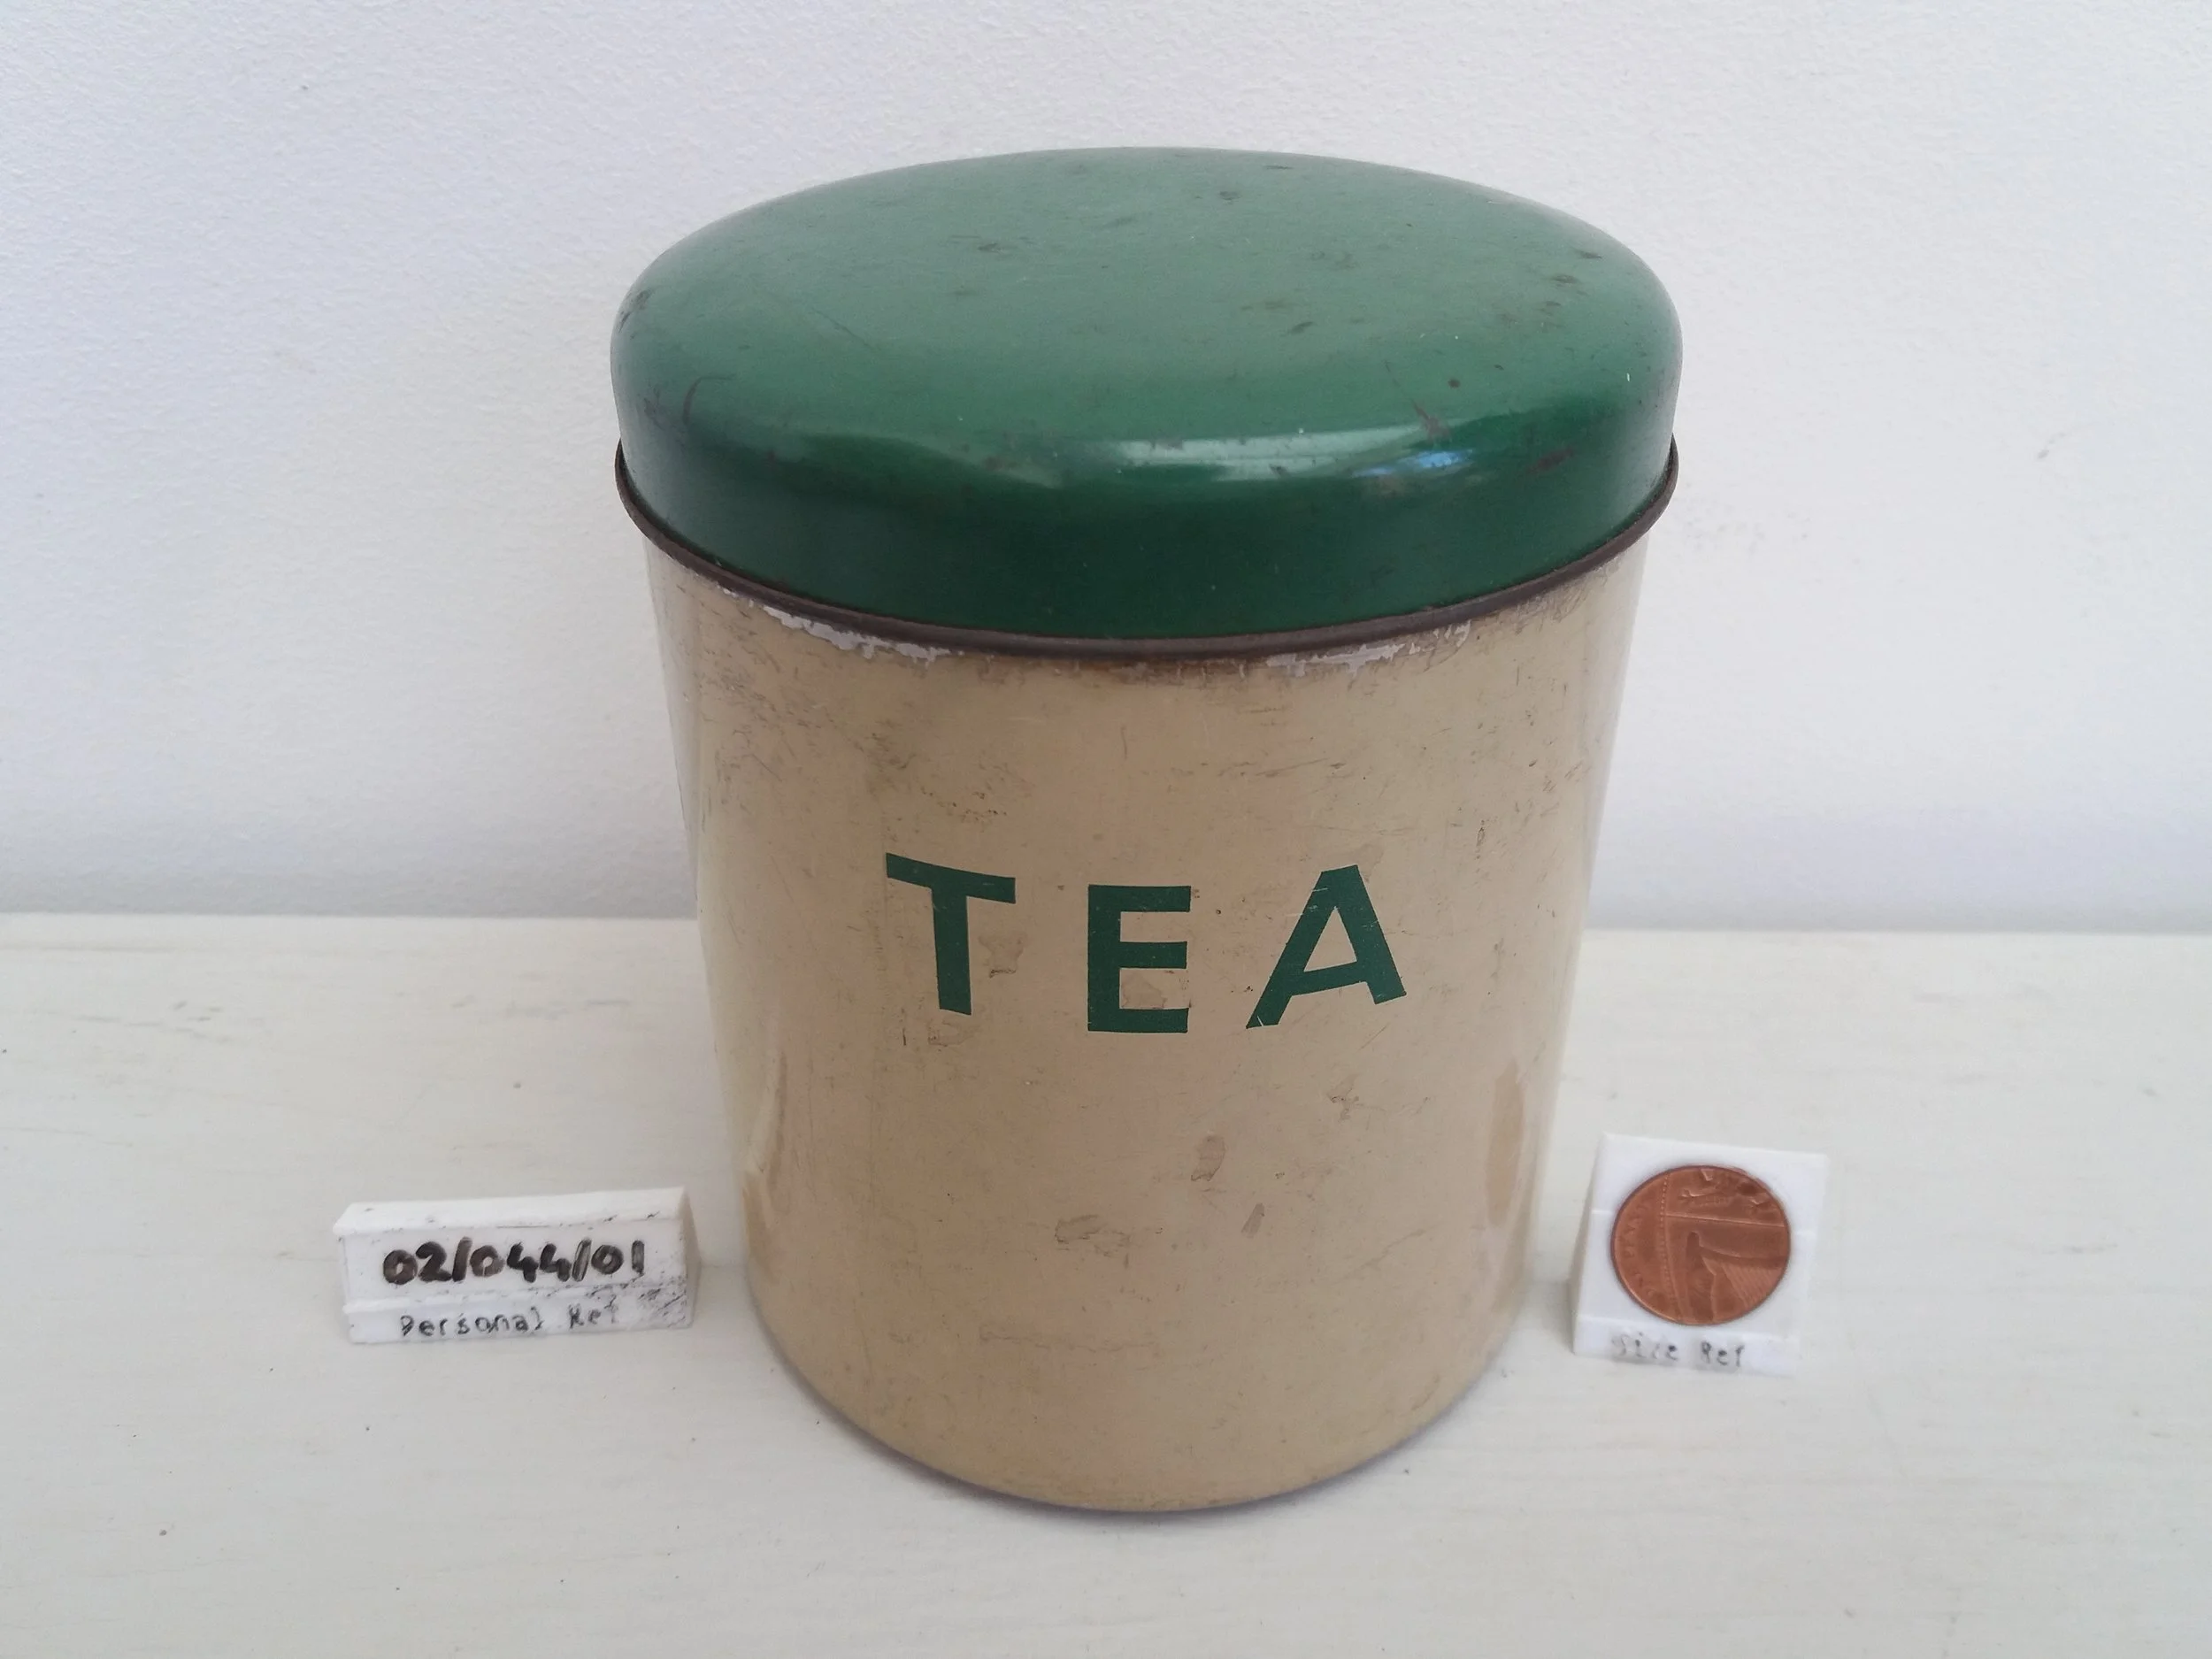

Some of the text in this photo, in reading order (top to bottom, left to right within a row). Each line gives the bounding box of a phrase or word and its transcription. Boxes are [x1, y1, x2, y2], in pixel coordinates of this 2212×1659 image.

[886, 852, 1407, 1033] TEA
[382, 1236, 645, 1286] 02/044/01
[400, 1306, 544, 1337] Personal
